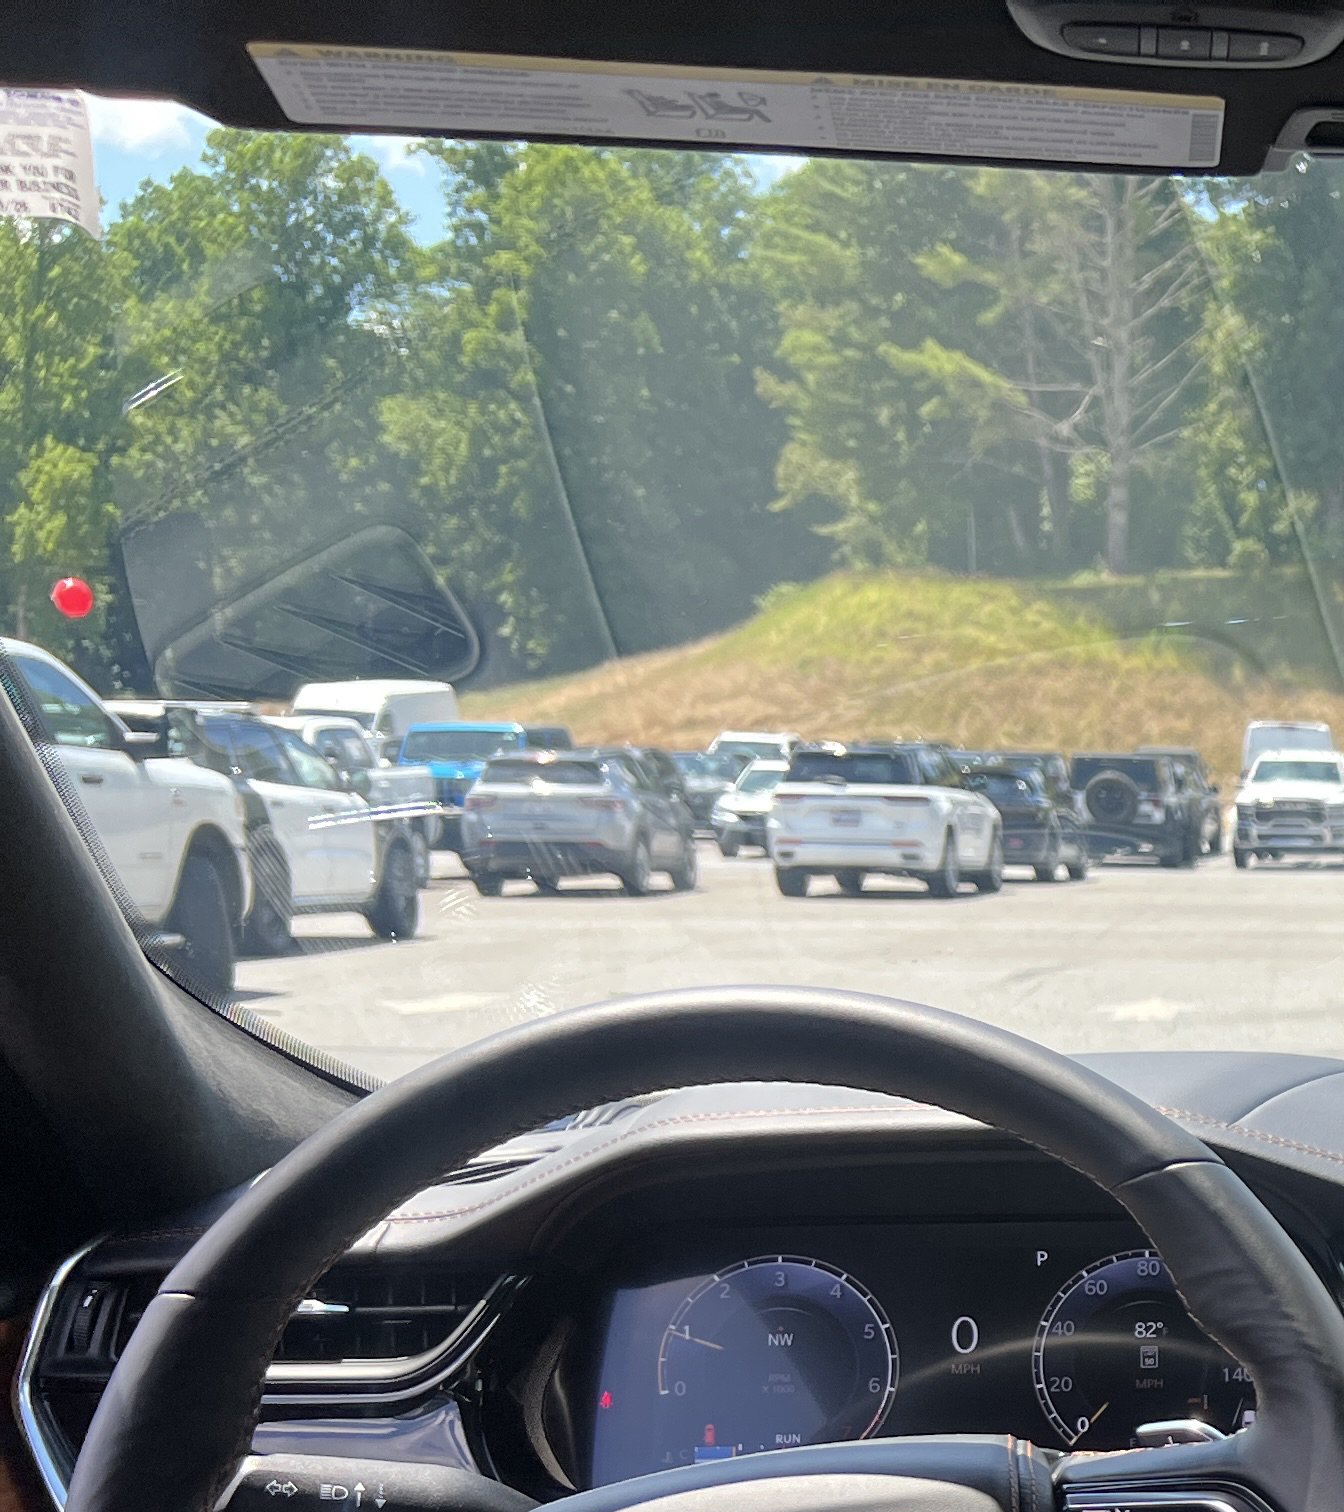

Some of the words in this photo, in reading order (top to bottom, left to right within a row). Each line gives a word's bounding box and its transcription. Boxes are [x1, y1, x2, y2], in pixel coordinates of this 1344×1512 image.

[1036, 1251, 1048, 1266] P
[1136, 1261, 1160, 1276] 80
[774, 1272, 785, 1286] 3
[720, 1284, 730, 1298] 2
[830, 1284, 842, 1298] 4
[1084, 1280, 1108, 1295] 60
[683, 1325, 691, 1339] 1
[864, 1324, 875, 1339] 5
[951, 1316, 979, 1354] 0
[1052, 1321, 1075, 1336] 40
[768, 1333, 794, 1347] NW
[951, 1364, 980, 1375] MPH
[675, 1382, 686, 1395] 0
[868, 1378, 880, 1392] 6
[1050, 1377, 1072, 1392] 20
[1136, 1378, 1164, 1389] MPH
[1077, 1417, 1089, 1432] 0
[775, 1434, 801, 1444] RUN
